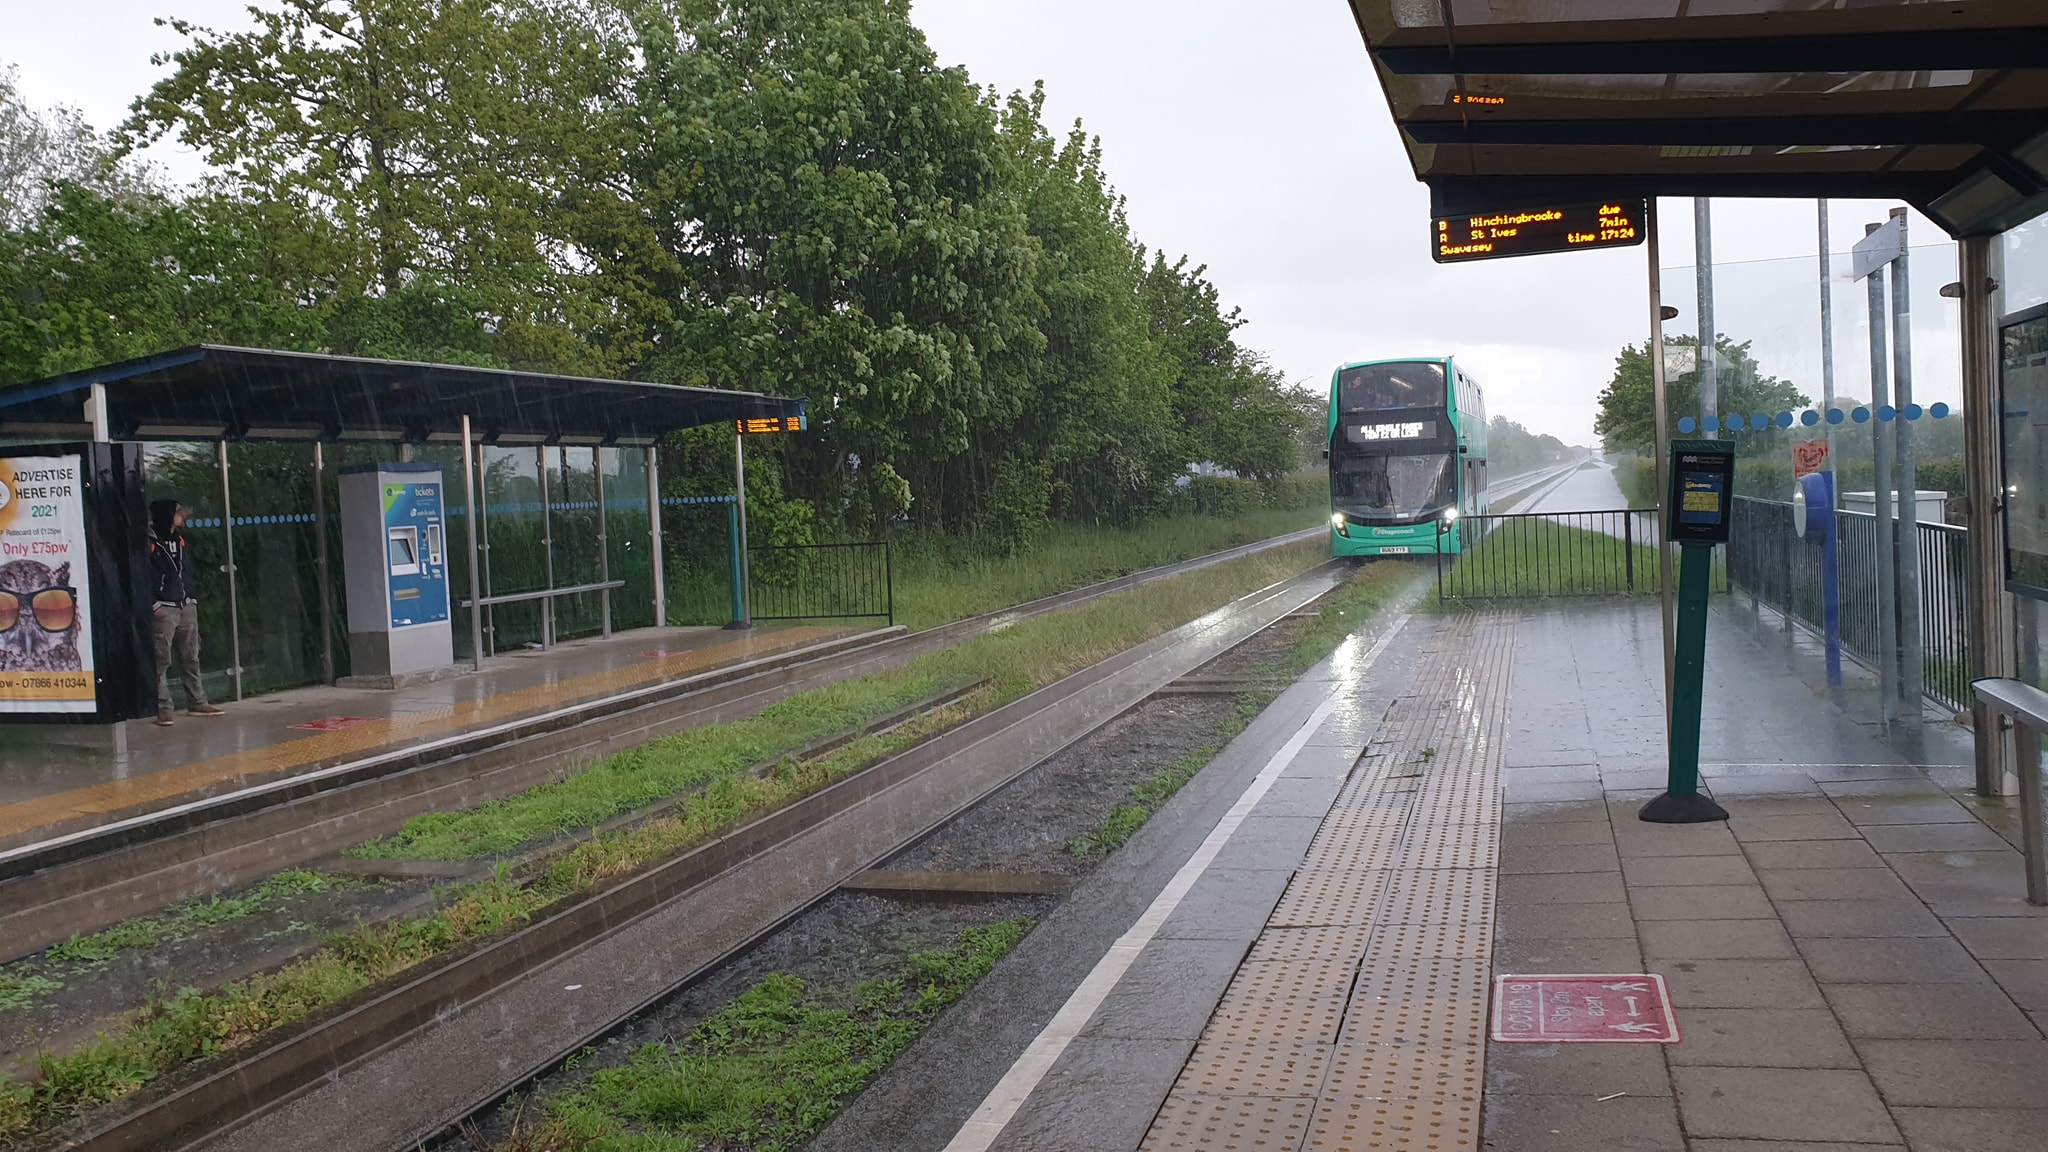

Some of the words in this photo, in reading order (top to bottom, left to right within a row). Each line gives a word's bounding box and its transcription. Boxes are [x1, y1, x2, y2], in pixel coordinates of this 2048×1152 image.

[1439, 221, 1447, 231] B
[1470, 210, 1562, 228] Hinchingbrooke
[1599, 204, 1621, 215] due
[1440, 233, 1448, 243] A
[1471, 230, 1485, 240] St
[1491, 228, 1517, 238] Ives
[1599, 216, 1628, 228] 7min
[1440, 243, 1492, 255] Swavesey
[1567, 232, 1595, 243] time
[1600, 227, 1635, 240] 17:24
[12, 468, 74, 483] ADVERTISE
[15, 487, 47, 500] HERE
[50, 486, 72, 498] FOR
[415, 485, 435, 496] tickets
[31, 504, 58, 518] 2021
[6, 528, 32, 536] Ratecard
[33, 528, 40, 536] of
[3, 542, 29, 556] Only
[22, 678, 51, 688] 07866
[54, 678, 86, 688] 410344
[1550, 991, 1570, 1004] 2m
[1550, 1004, 1575, 1023] Stay
[1584, 996, 1609, 1017] apart
